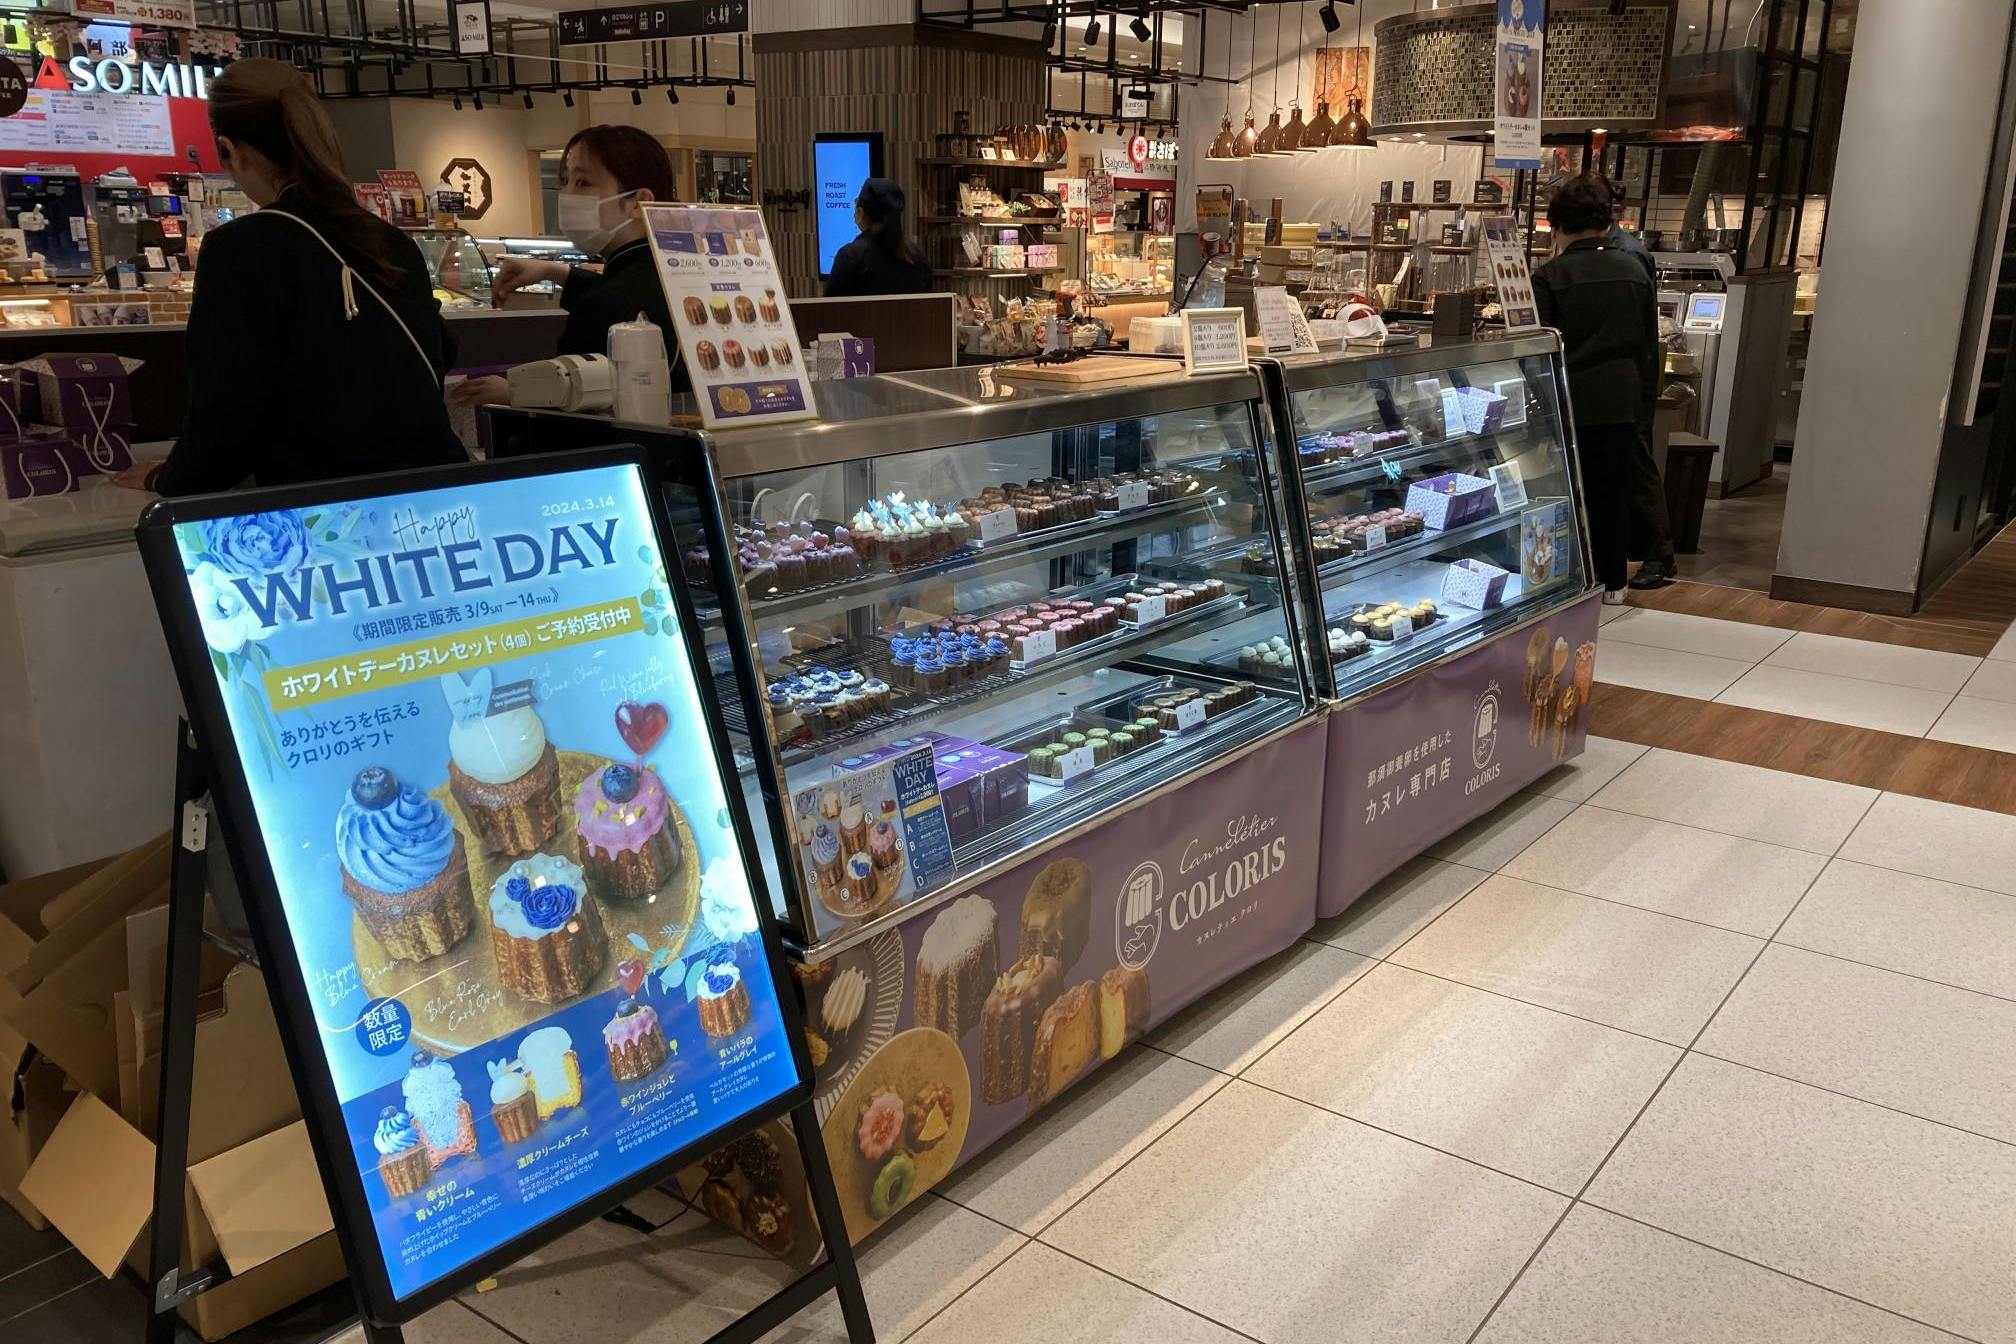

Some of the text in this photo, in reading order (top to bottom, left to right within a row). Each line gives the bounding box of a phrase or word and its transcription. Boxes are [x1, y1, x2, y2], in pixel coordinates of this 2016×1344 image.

[35, 56, 224, 99] ASO MIL
[542, 495, 615, 517] 2024.3.14
[393, 505, 475, 551] Happy
[230, 518, 619, 628] WHITE DAY
[281, 701, 420, 748] ありがとうを伝える
[288, 729, 395, 769] クロリのギフト
[895, 757, 933, 779] WHITE
[905, 771, 928, 789] DAY
[1465, 763, 1501, 796] COLORIS
[1365, 757, 1452, 825] カヌレ専門店
[907, 824, 914, 835] A
[910, 841, 916, 851] B
[913, 859, 919, 869] C
[917, 877, 924, 887] D
[1169, 835, 1286, 931] COLORIS
[363, 1004, 400, 1031] 数量
[368, 1025, 406, 1052] 限定
[719, 1044, 757, 1071] アールグレイ
[628, 1090, 673, 1116] ブルーベリー
[415, 1187, 476, 1223] 青いクリーム
[425, 1180, 457, 1203] 幸せの
